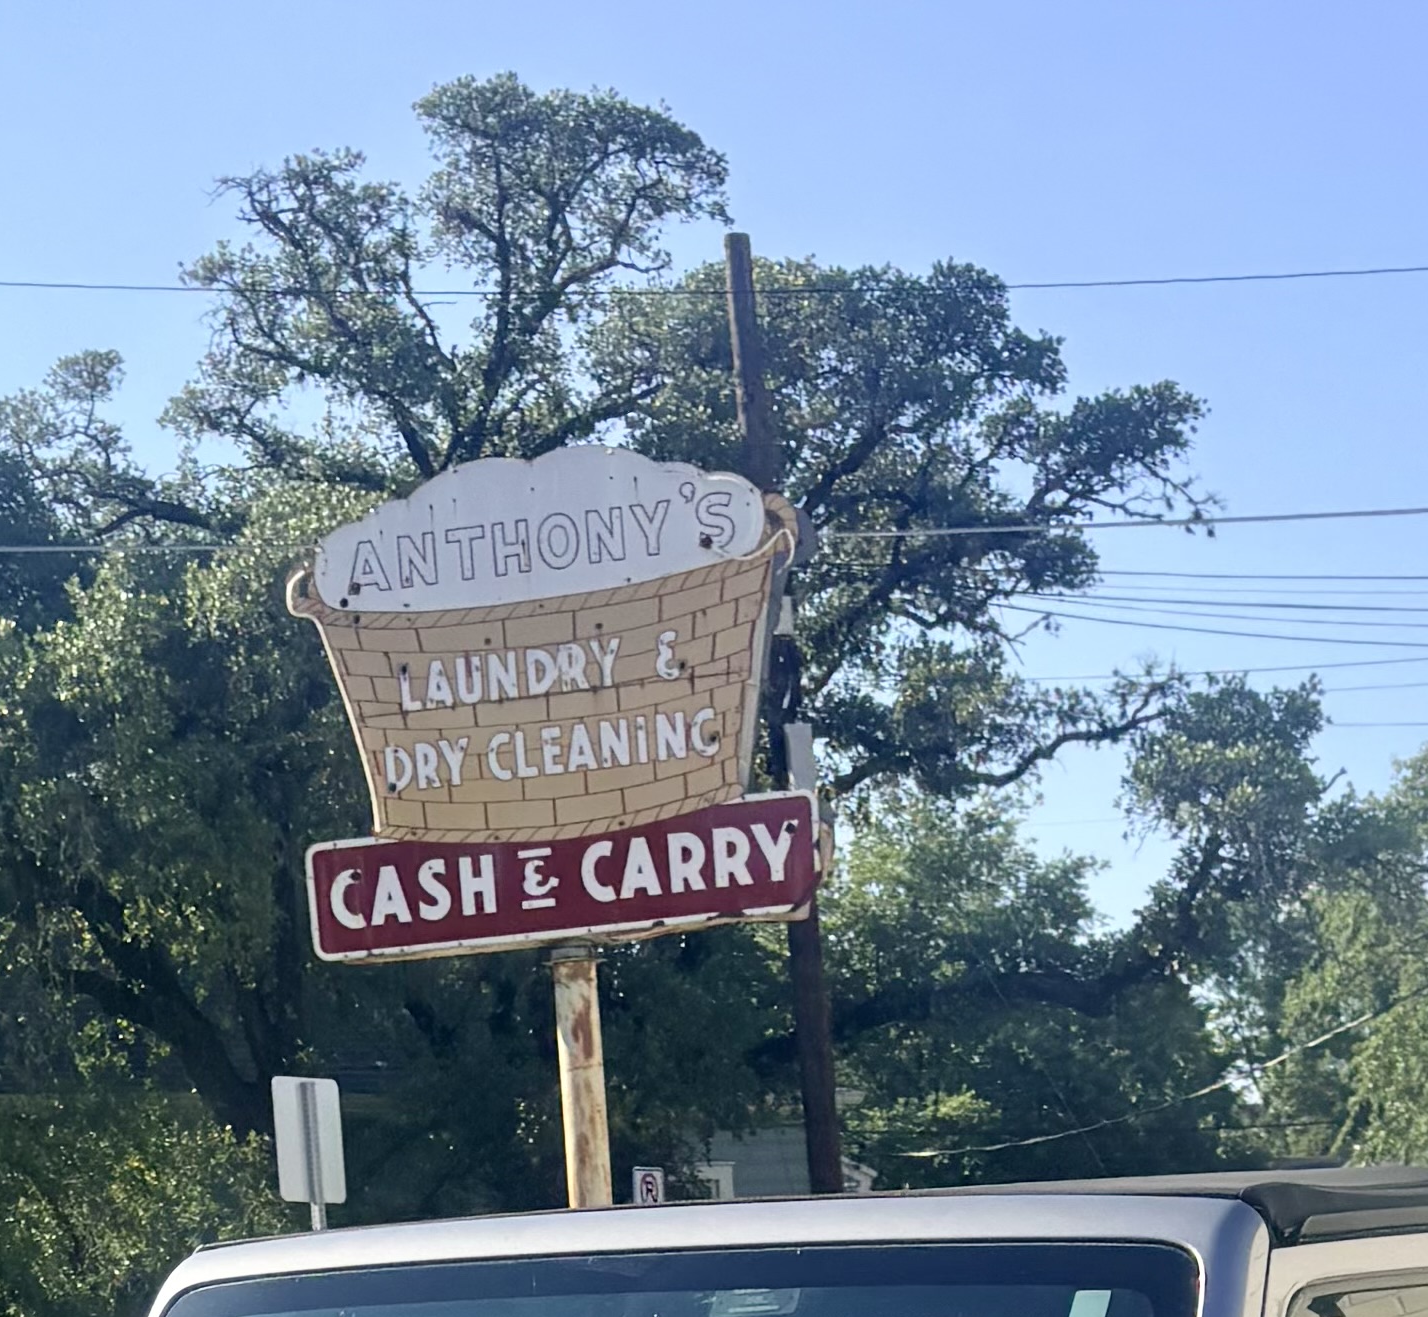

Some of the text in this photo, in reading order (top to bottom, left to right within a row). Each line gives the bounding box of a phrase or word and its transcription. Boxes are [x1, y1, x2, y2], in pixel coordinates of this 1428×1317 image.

[348, 481, 736, 596] ANTHONY'S
[399, 631, 685, 713] LAUNDRY &
[383, 707, 720, 794] DRY CLEANING
[330, 819, 800, 930] CASH & CARRY
